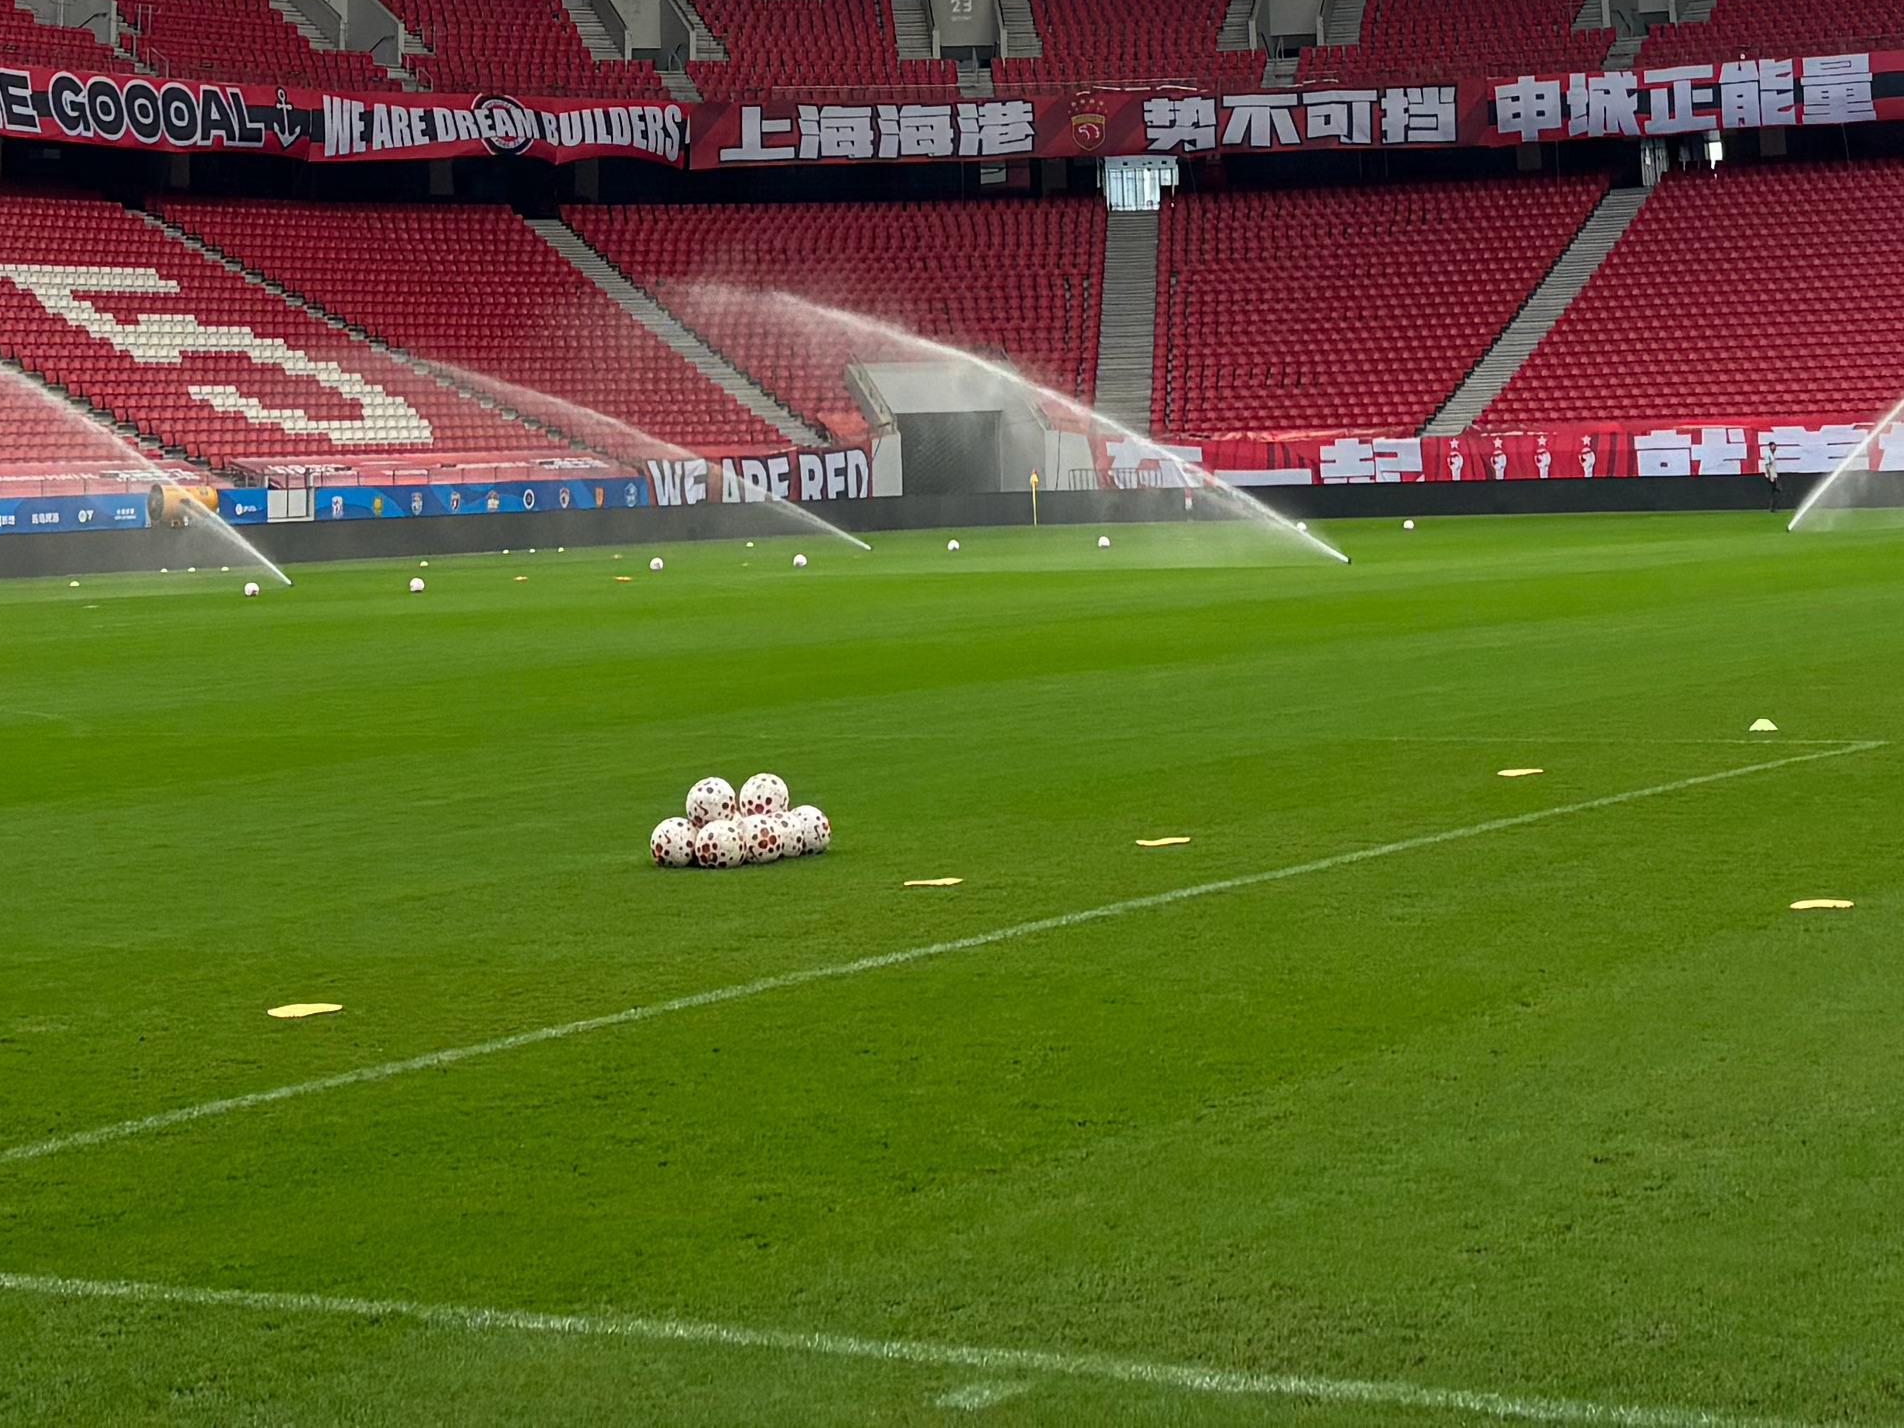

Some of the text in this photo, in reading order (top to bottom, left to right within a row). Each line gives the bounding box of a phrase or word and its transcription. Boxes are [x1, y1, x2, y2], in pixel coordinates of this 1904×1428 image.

[49, 71, 266, 147] GOOOAL
[322, 94, 683, 162] WE ARE DREAM BUILDERS
[718, 85, 1458, 162] 上海海港 势不可挡
[1495, 53, 1878, 144] 申城正能量
[647, 459, 707, 506] WE
